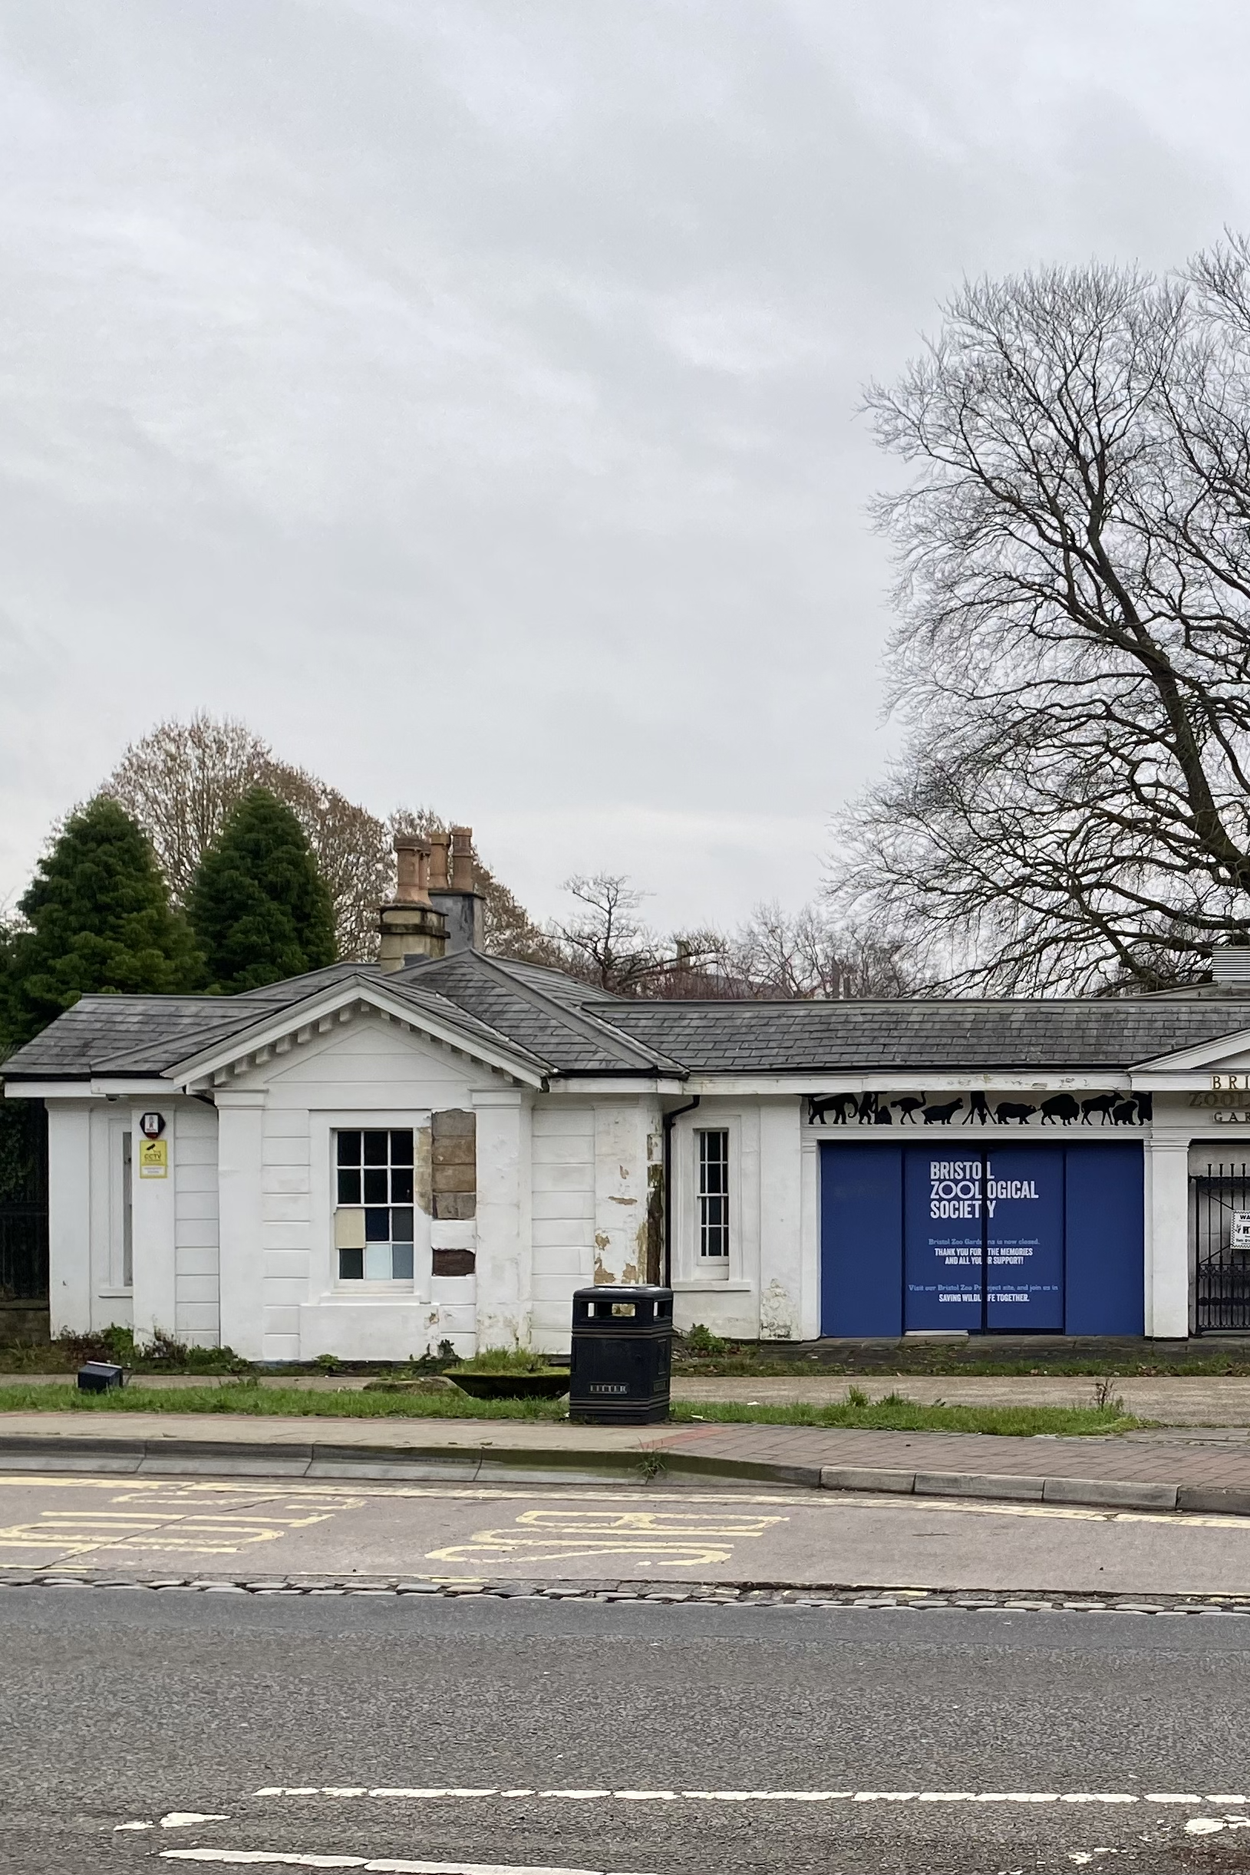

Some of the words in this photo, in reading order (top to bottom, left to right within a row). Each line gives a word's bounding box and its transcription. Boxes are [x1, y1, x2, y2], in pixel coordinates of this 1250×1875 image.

[930, 1162, 994, 1180] BRISTOL
[930, 1180, 1039, 1199] ZOOLOGICAL
[930, 1200, 996, 1218] SOCIETY
[424, 1510, 790, 1566] BUS
